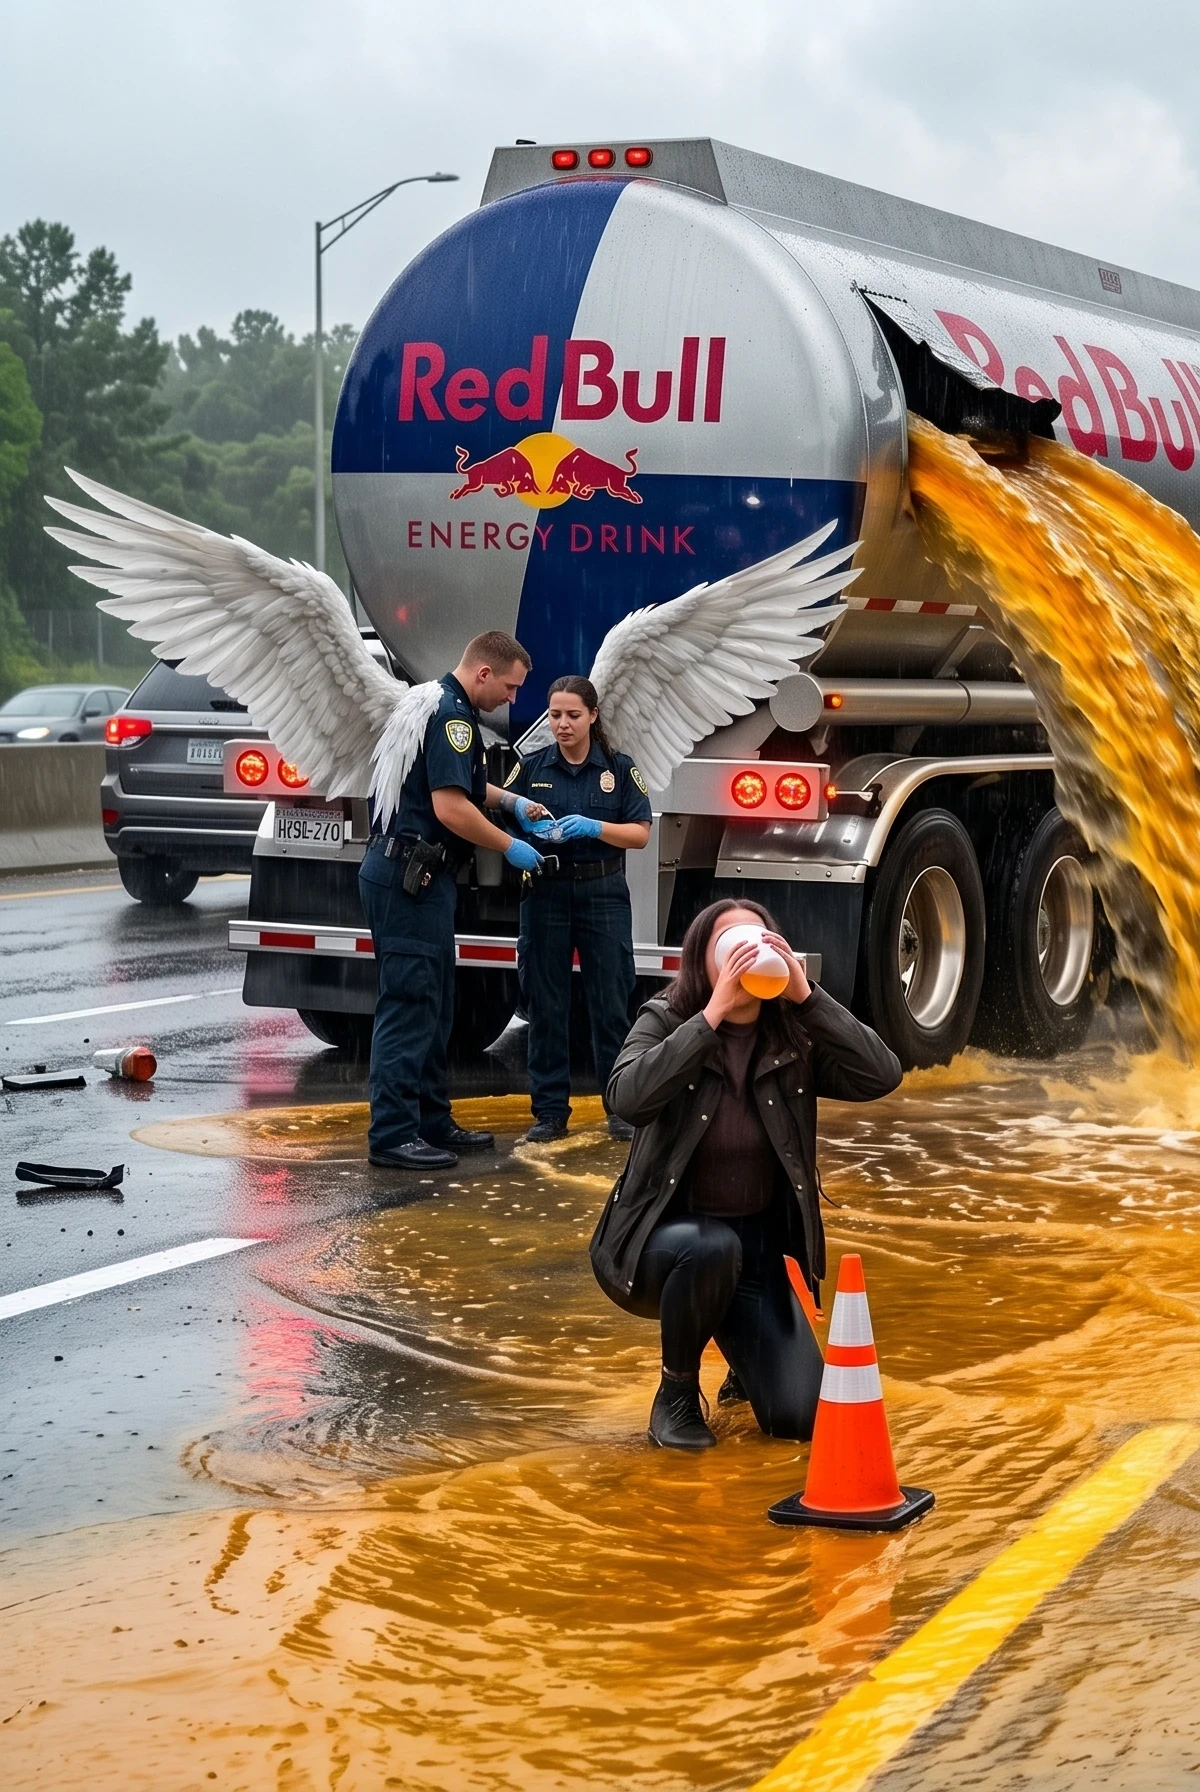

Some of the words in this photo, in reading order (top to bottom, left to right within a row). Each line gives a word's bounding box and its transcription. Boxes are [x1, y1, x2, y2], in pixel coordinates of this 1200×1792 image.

[399, 335, 549, 421] Red
[560, 336, 726, 423] Bull
[407, 520, 553, 551] ENERGY
[570, 523, 696, 555] DRINK
